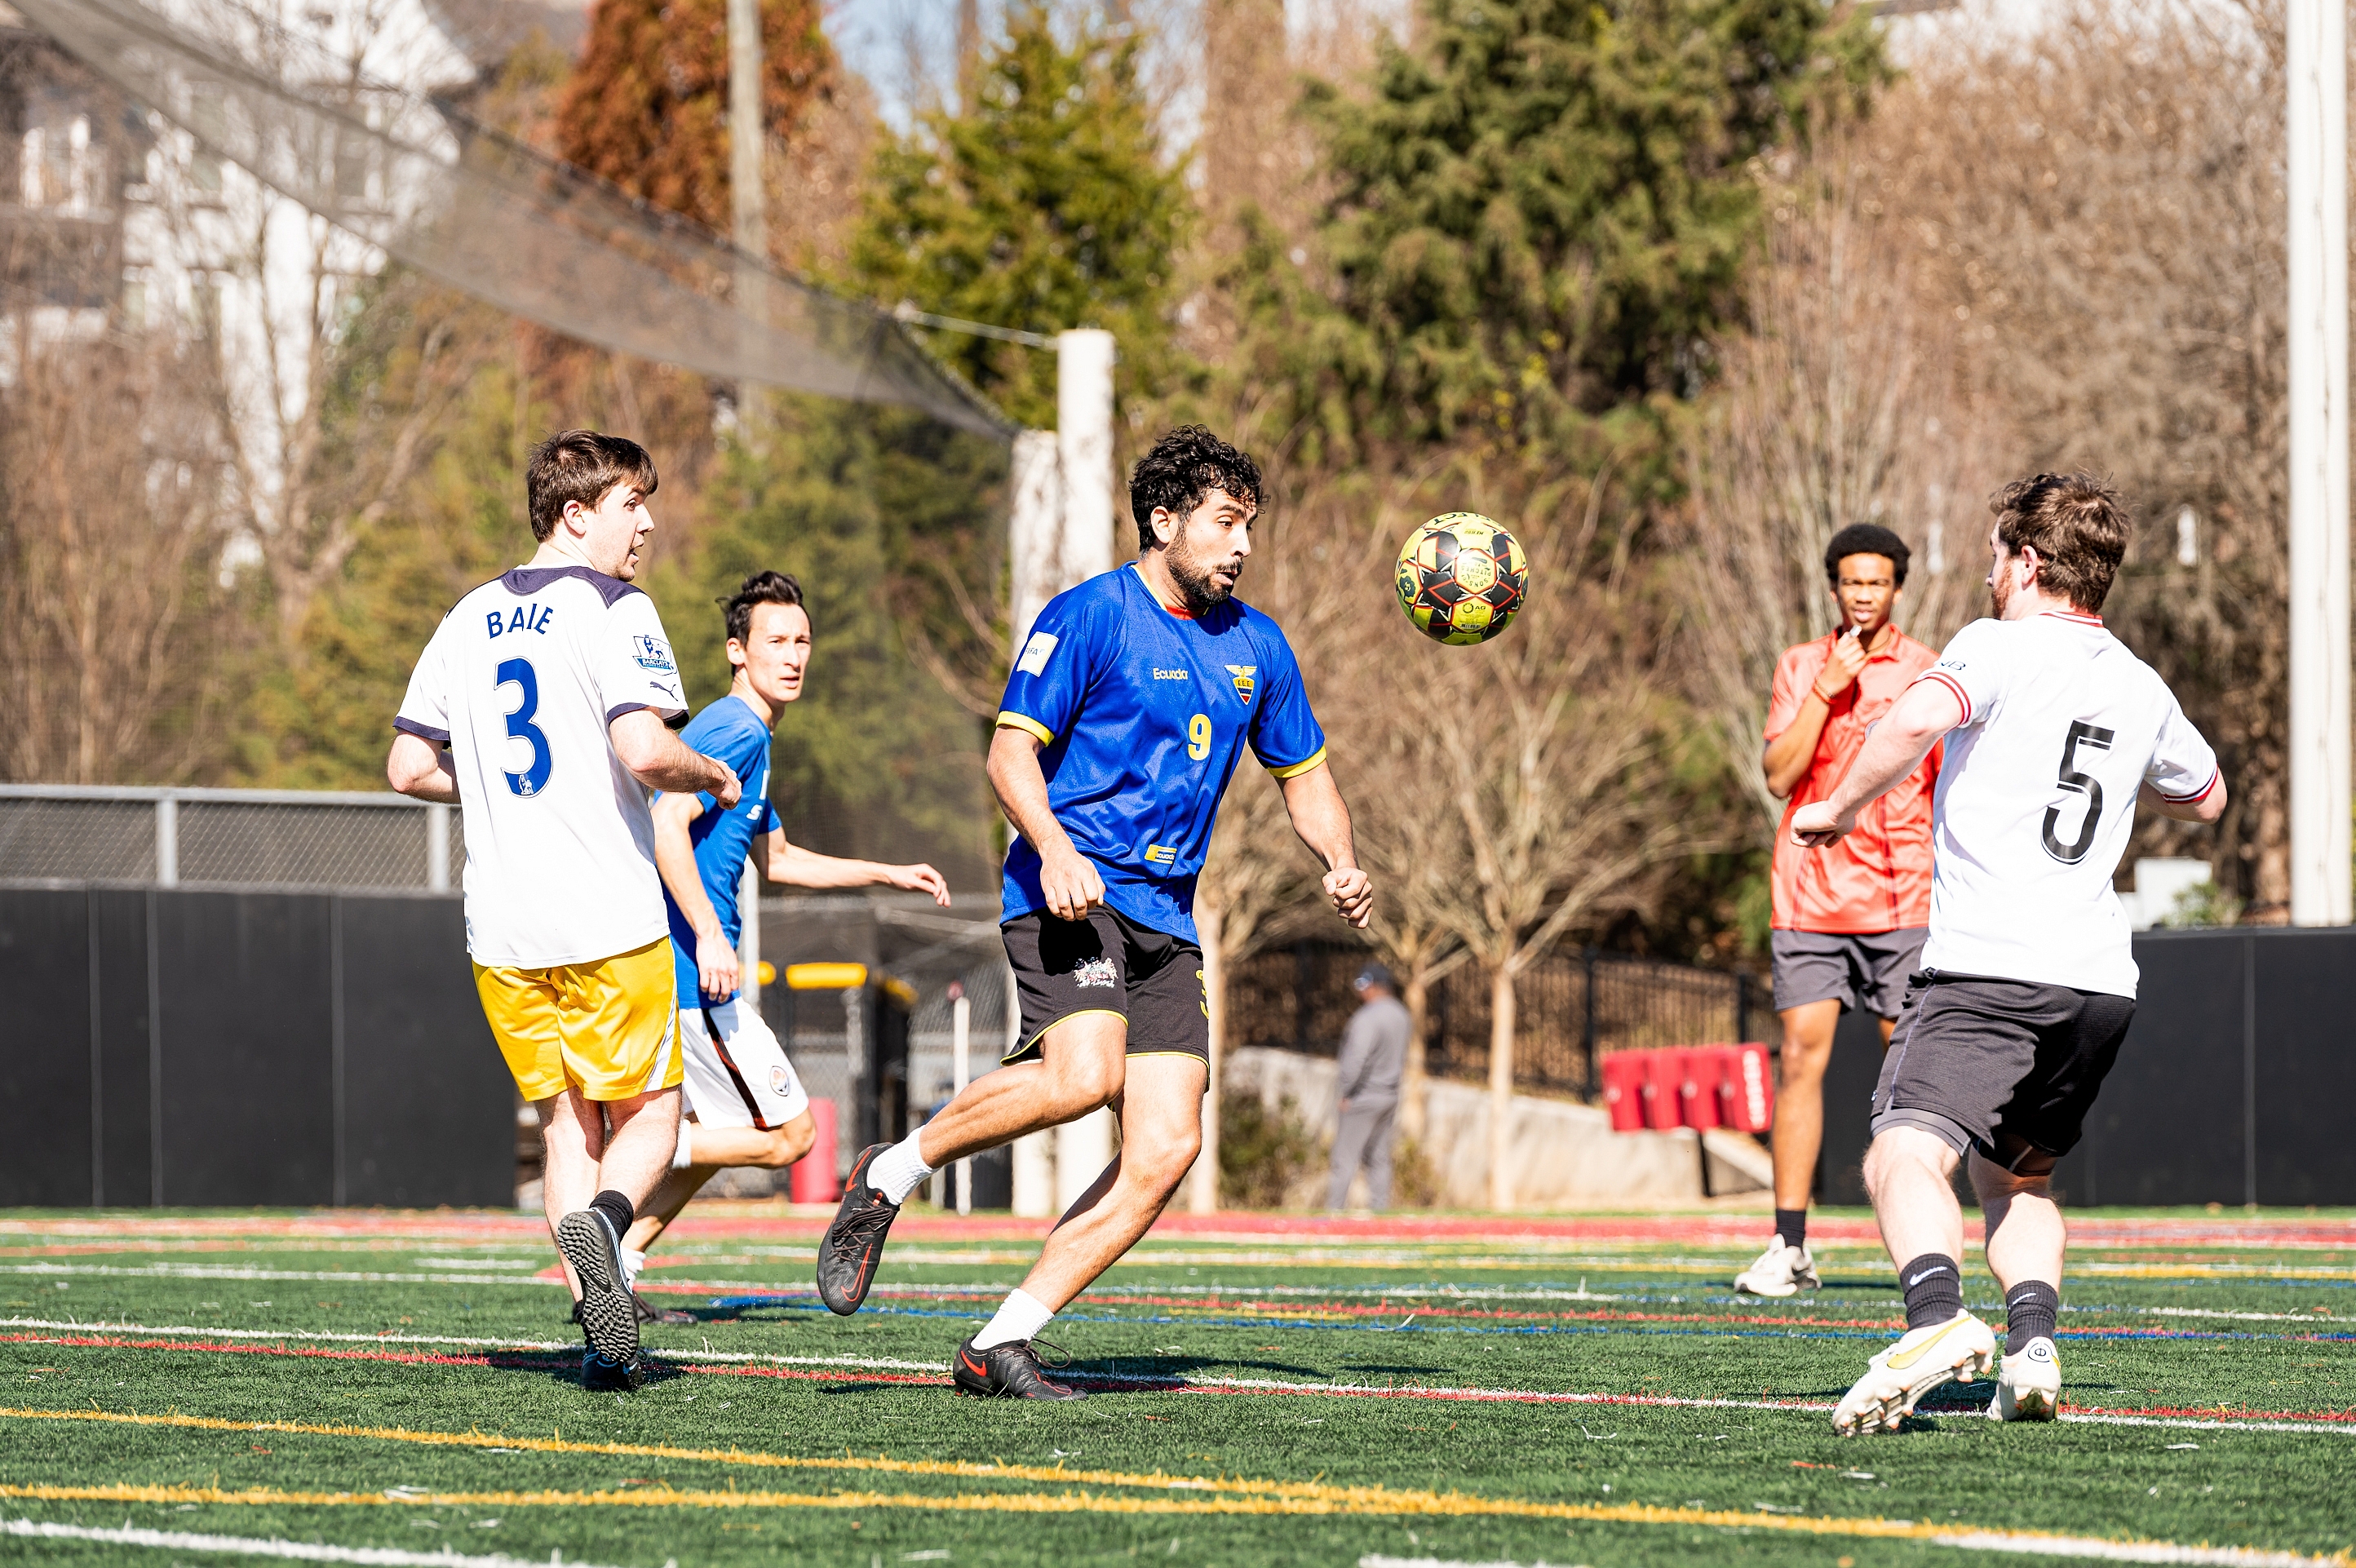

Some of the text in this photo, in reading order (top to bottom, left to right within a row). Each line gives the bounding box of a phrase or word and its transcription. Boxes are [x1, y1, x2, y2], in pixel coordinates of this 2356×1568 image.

[487, 604, 553, 639] BAIE
[494, 657, 552, 798] 3
[1188, 713, 1212, 760] 9
[2040, 720, 2115, 865] 5
